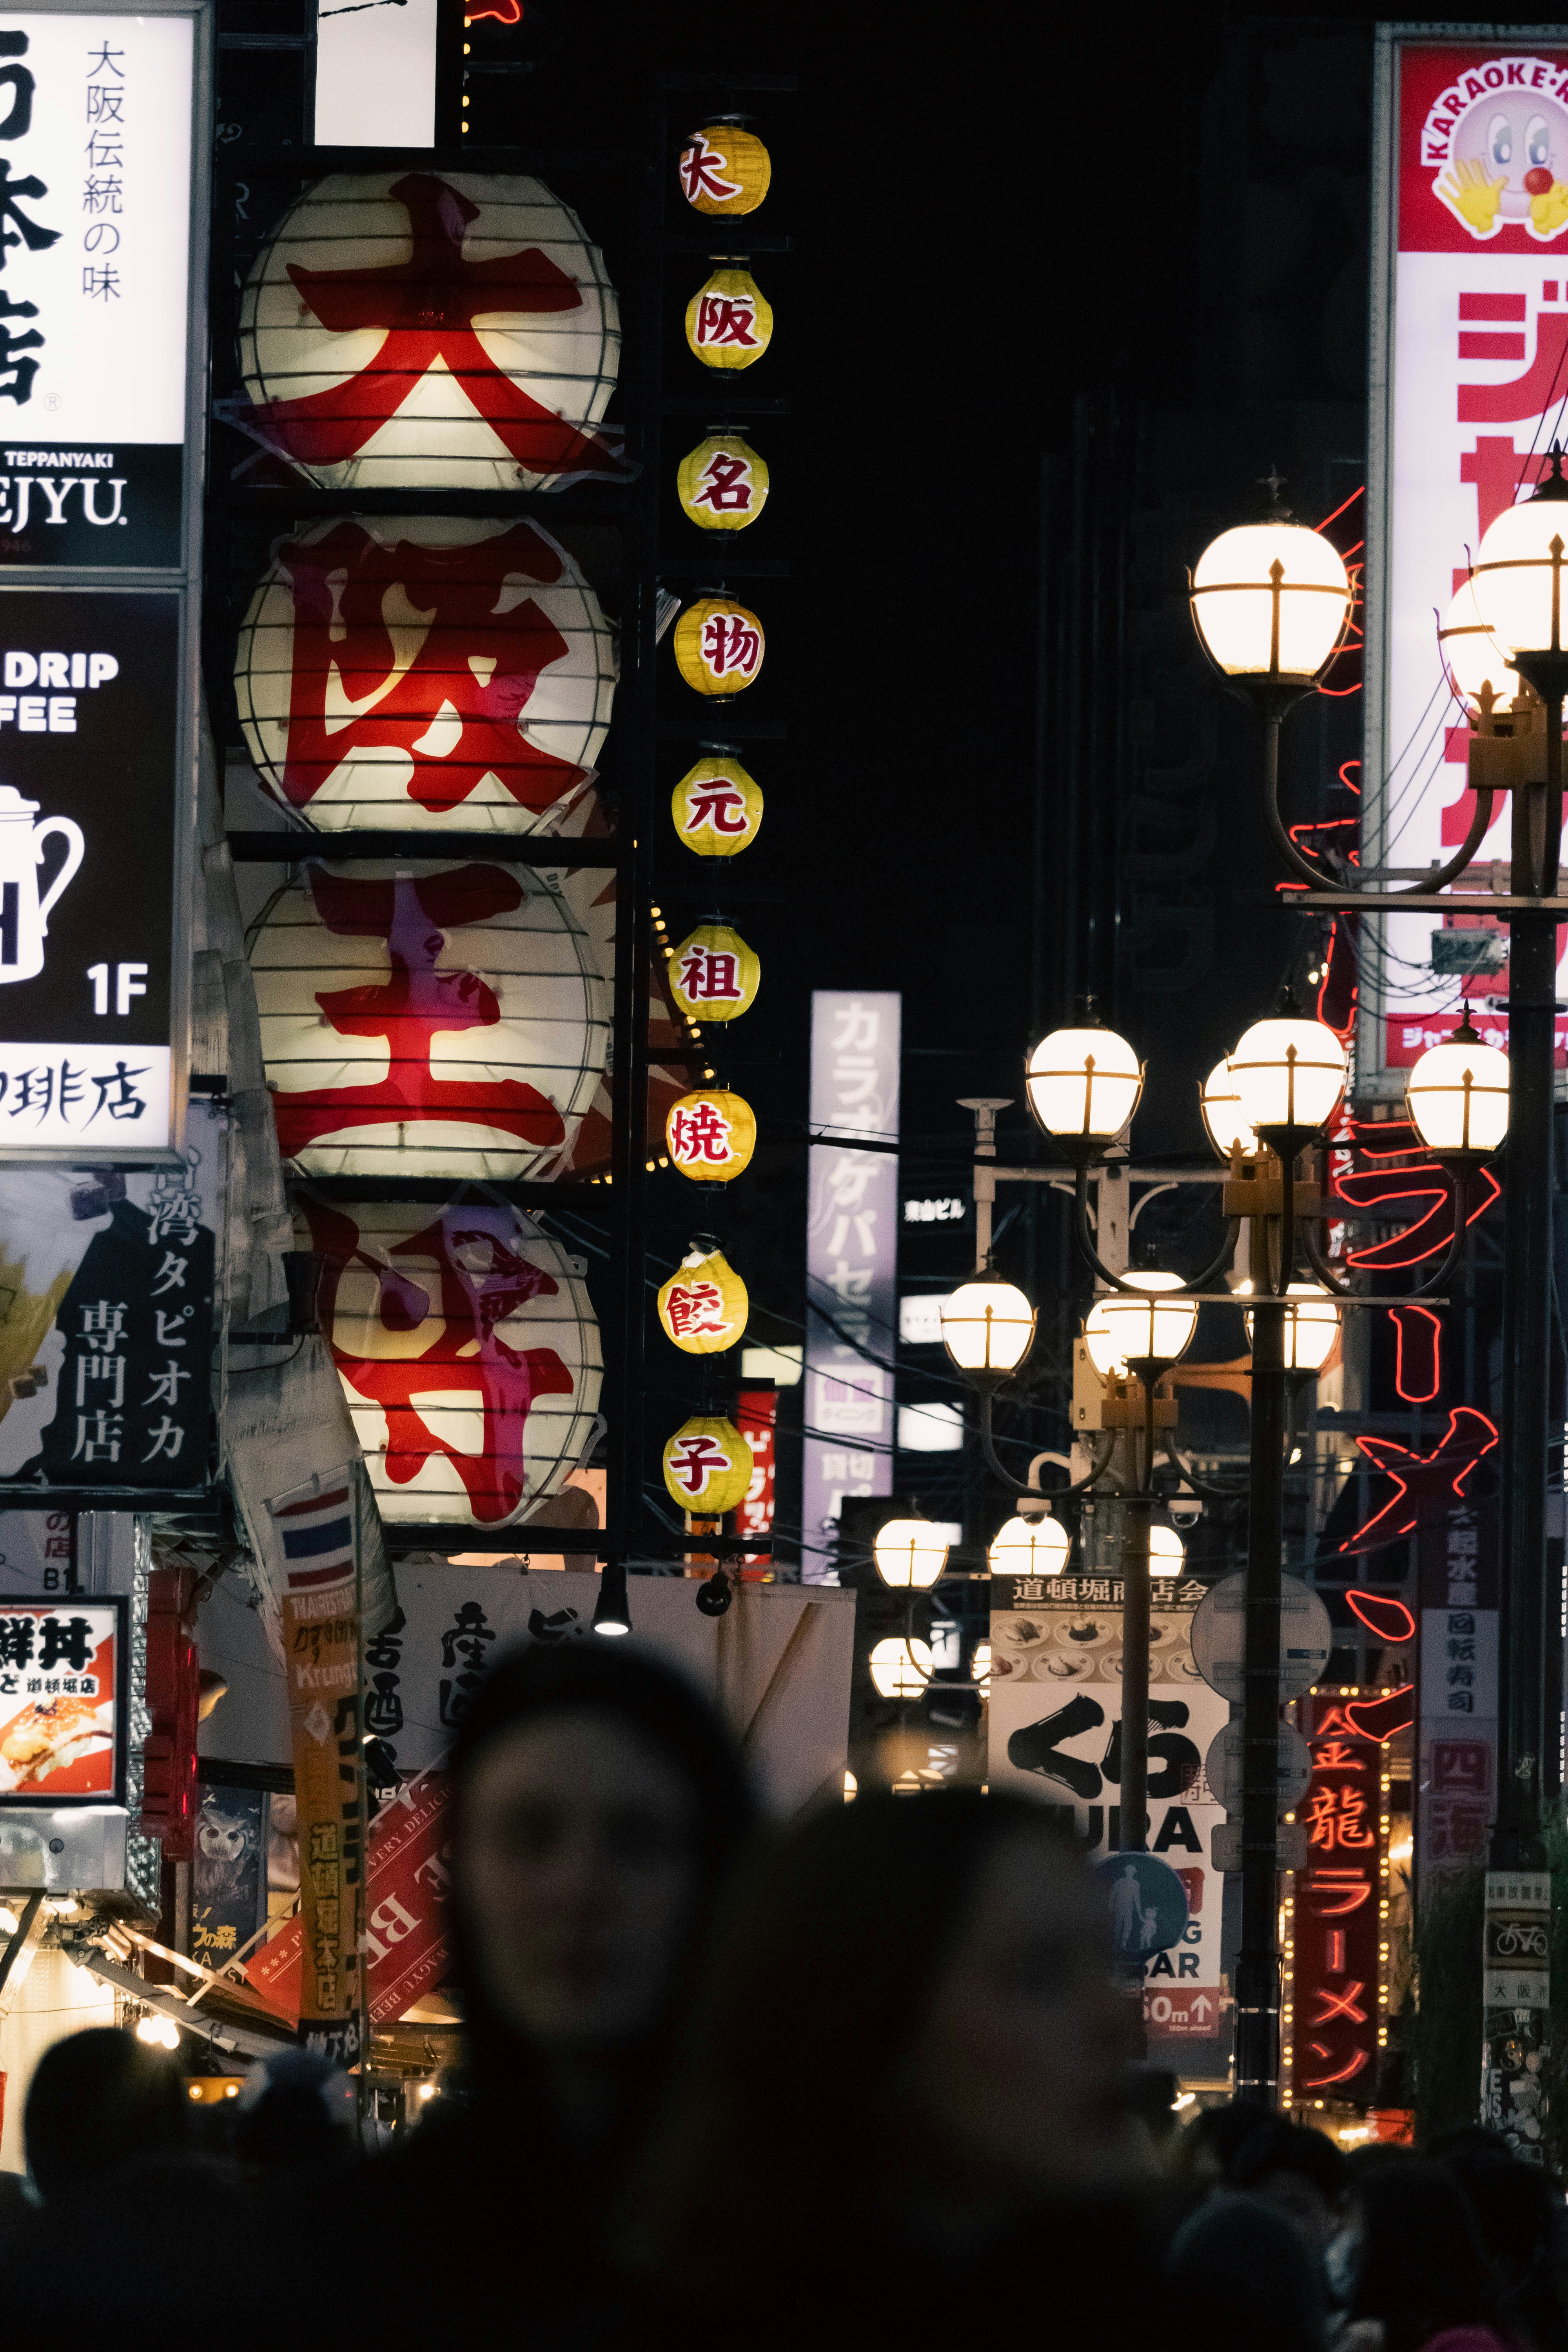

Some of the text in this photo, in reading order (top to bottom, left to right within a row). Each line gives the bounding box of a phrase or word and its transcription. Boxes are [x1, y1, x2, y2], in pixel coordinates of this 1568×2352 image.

[82, 40, 126, 302] 大阪伝統の味
[5, 451, 114, 468] TEPPANYAKI
[5, 652, 118, 688] DRIP
[87, 963, 148, 1014] 1F
[0, 1058, 153, 1133] 琲店
[72, 1300, 129, 1462] 専門店
[1305, 1706, 1374, 2087] 金龍ラーメン
